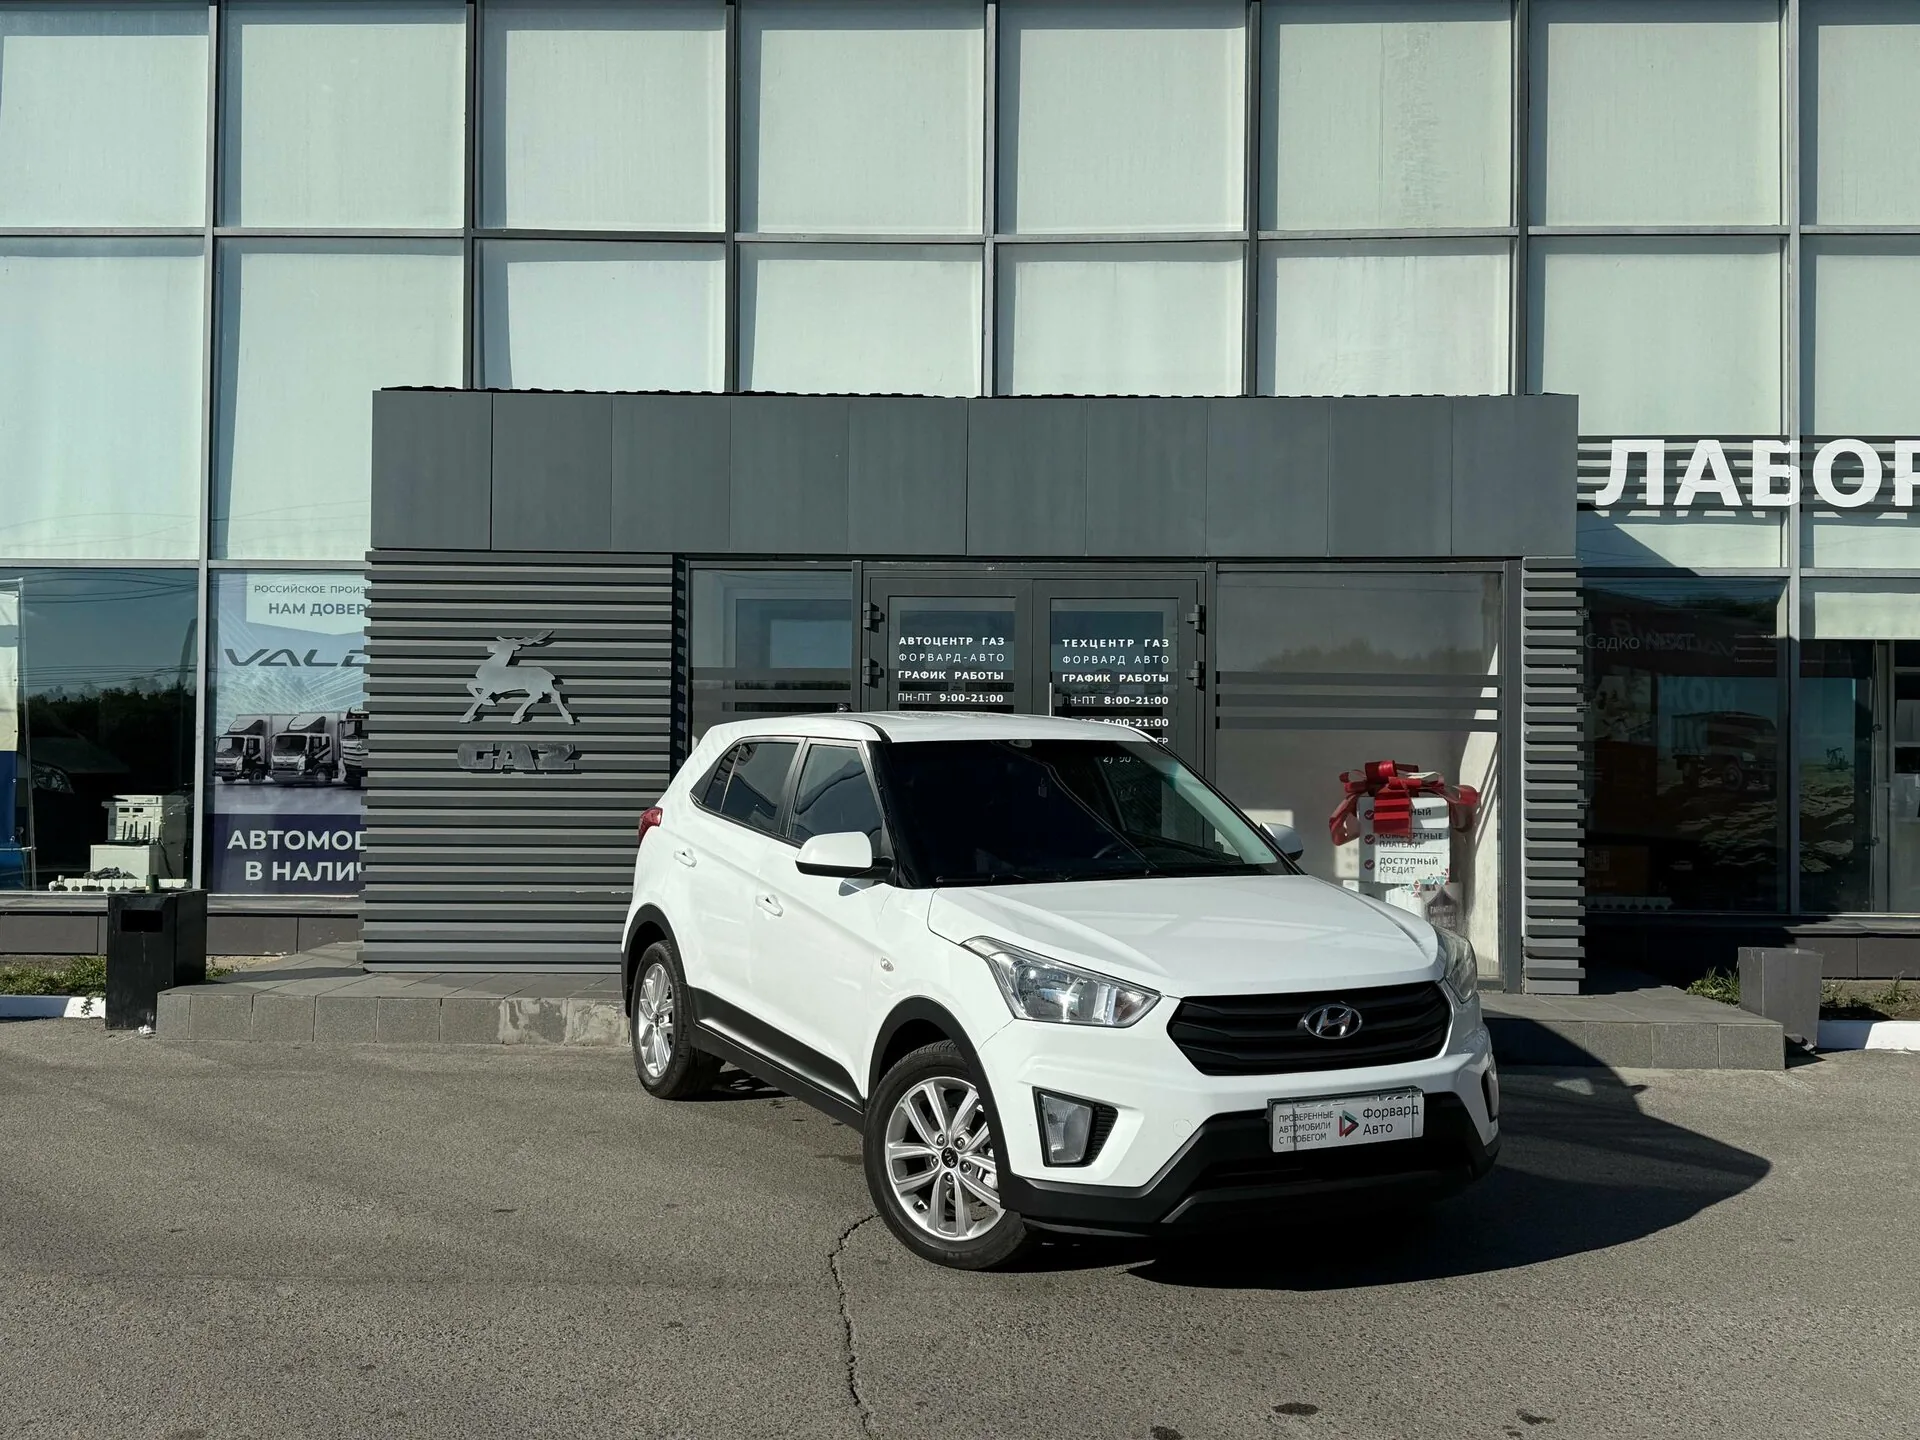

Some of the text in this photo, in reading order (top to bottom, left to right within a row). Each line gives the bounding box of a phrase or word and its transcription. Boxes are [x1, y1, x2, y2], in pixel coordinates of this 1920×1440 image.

[254, 584, 326, 594] РОССИЙСКОЕ
[268, 602, 371, 617] НАМ ДОВЕР
[899, 636, 1005, 648] АВТОЦЕНТР ГАЗ
[1062, 639, 1170, 649] ТЕХЦЕНТР ГАЗ
[1585, 632, 1641, 653] Садко
[899, 653, 1005, 664] ФОРВАРД-АВТО
[1062, 655, 1170, 666] ФОРВАРД АВТО
[898, 670, 1004, 680] ГРАФИК РАБОТЫ
[1062, 673, 1170, 683] ГРАФИК РАБОТЫ
[897, 693, 1004, 703] ПН-ПТ 9:00-21:00
[1103, 696, 1169, 705] 8:00-21:00
[1380, 857, 1438, 866] ДОСТУПНЫЙ
[245, 861, 263, 881] В
[1380, 866, 1415, 874] КРЕДИТ
[1279, 1104, 1419, 1123] ПРОВЕРЕННЫЕ Форвард
[1279, 1122, 1393, 1136] АВТОМОБИЛИ Авто
[1279, 1132, 1327, 1145] С ПРОБЕГОМ
